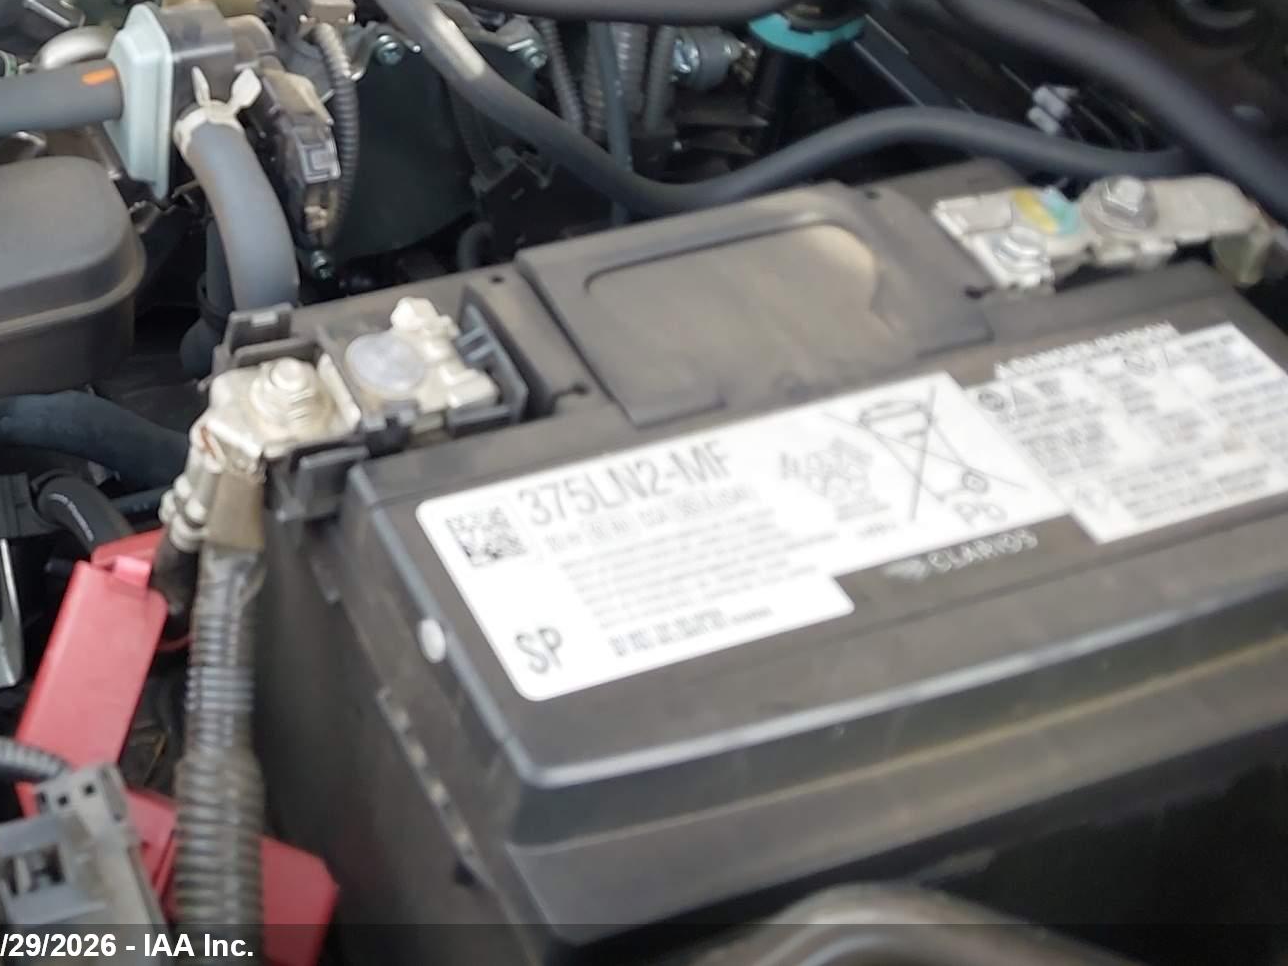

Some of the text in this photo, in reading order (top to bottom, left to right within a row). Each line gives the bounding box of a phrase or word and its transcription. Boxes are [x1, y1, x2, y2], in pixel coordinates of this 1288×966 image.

[517, 439, 733, 527] 375LN2-MF
[927, 528, 1039, 572] CLARIOS
[515, 626, 562, 675] SP
